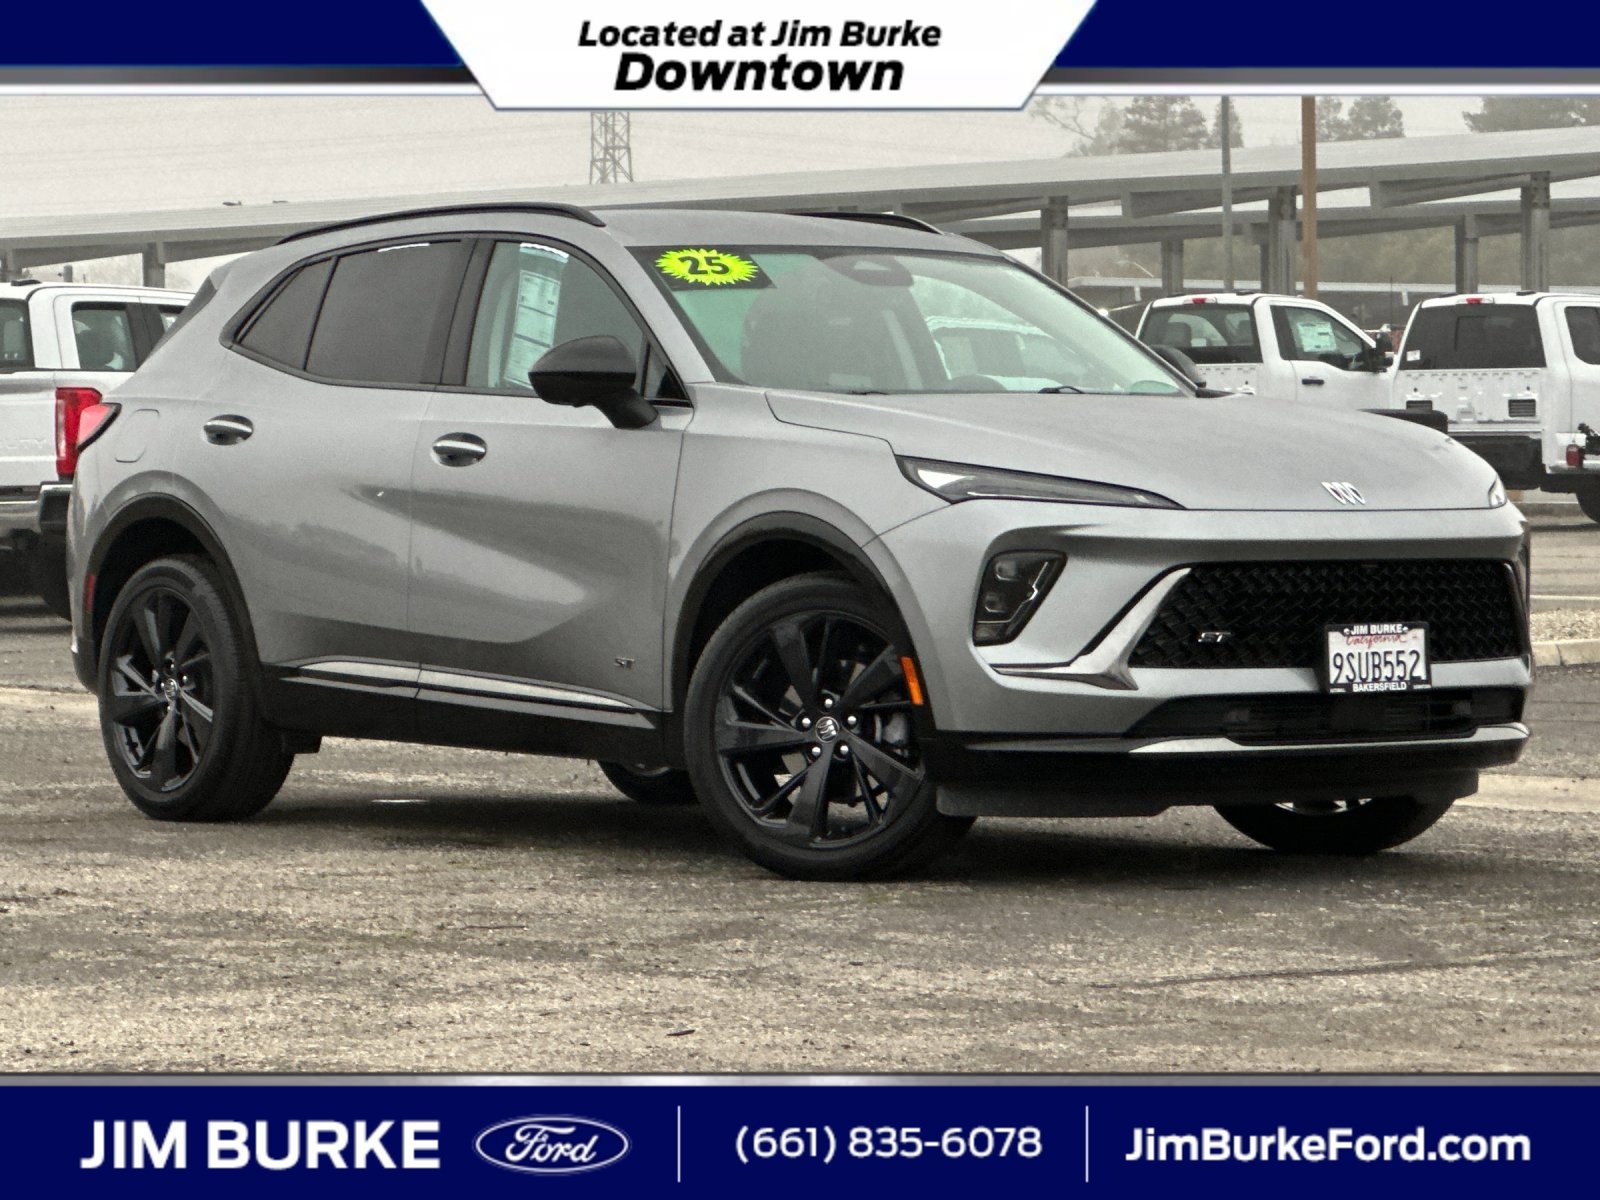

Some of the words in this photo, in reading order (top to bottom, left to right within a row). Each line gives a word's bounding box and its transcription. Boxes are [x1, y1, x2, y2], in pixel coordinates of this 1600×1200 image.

[677, 255, 730, 276] 25
[1351, 625, 1368, 635] JIM
[1370, 624, 1403, 634] BURKE
[1332, 650, 1420, 684] 9SUB552
[1352, 682, 1407, 692] BAKERSFIELD
